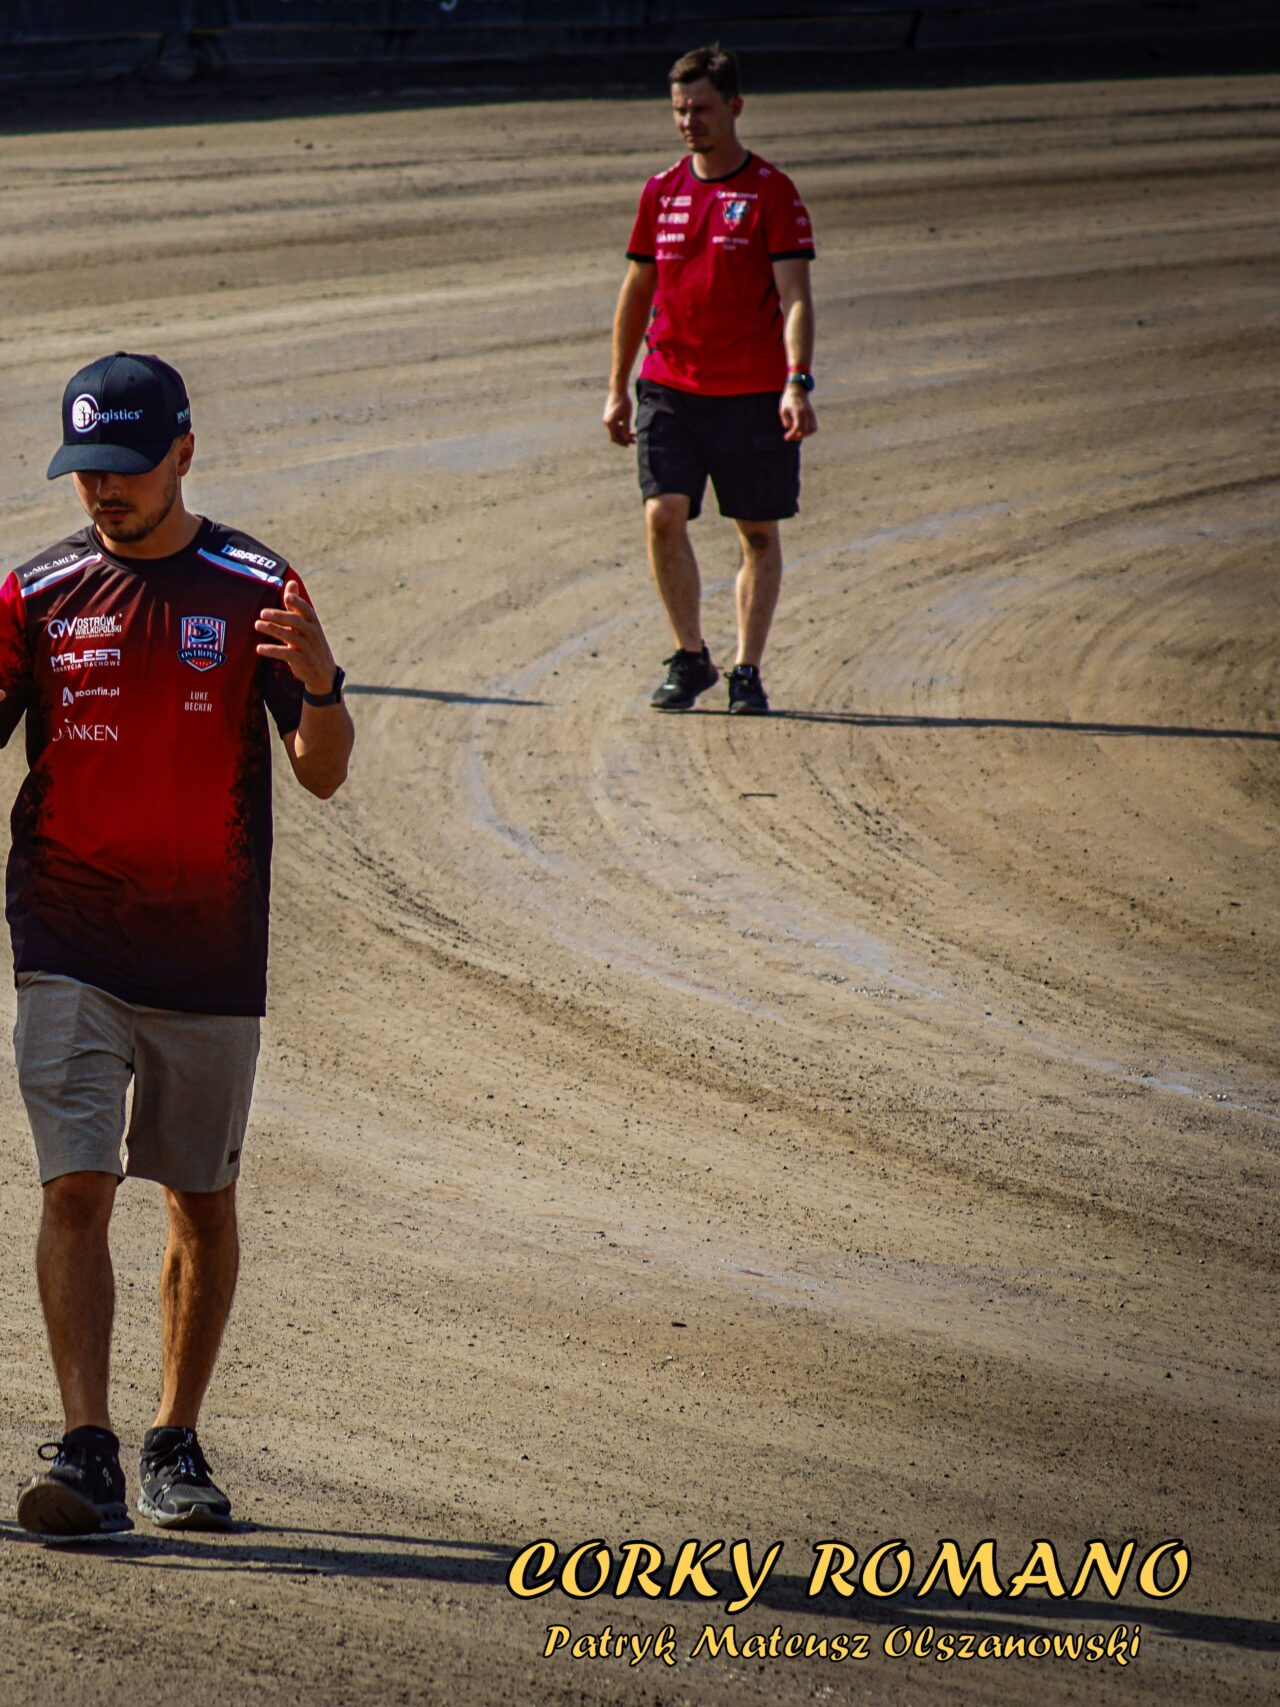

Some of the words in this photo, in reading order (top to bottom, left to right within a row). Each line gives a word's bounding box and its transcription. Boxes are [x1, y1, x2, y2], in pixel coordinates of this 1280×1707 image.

[77, 613, 116, 628] OSTRÓW
[190, 691, 209, 701] LUKE
[184, 701, 213, 712] BECKER
